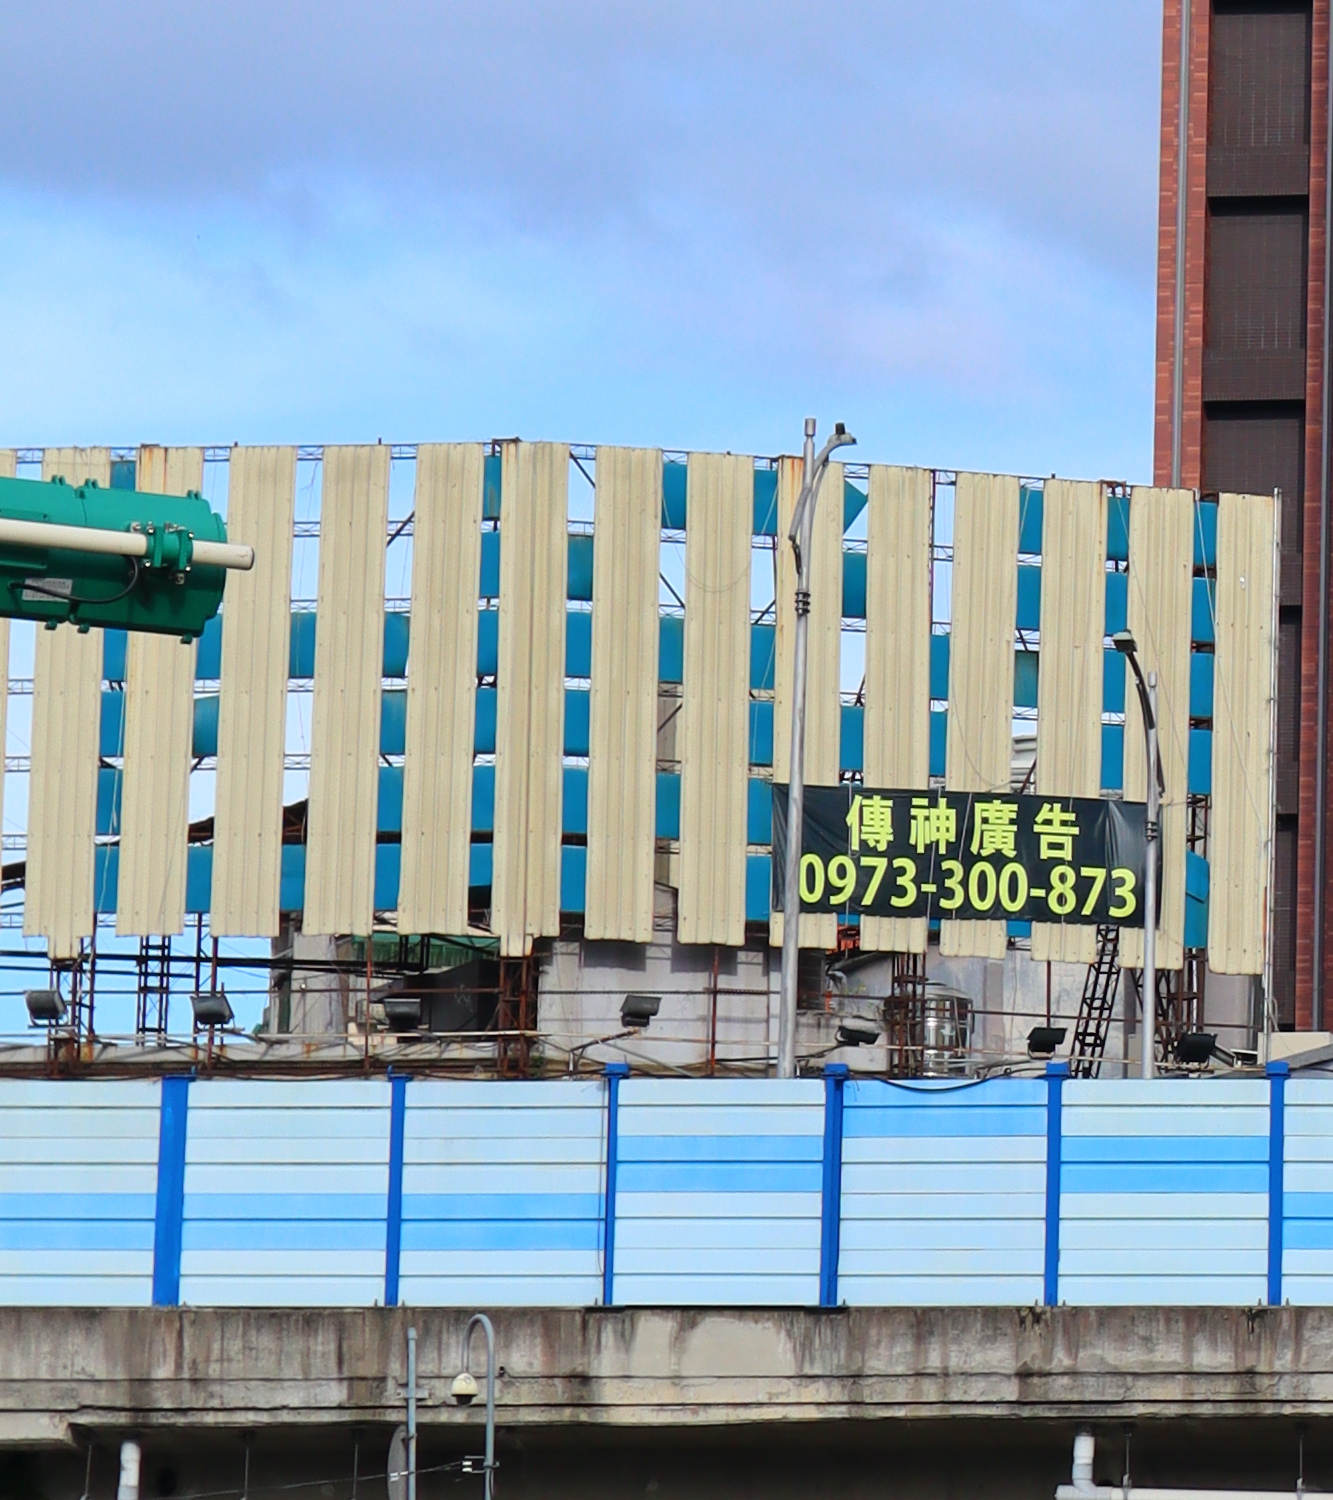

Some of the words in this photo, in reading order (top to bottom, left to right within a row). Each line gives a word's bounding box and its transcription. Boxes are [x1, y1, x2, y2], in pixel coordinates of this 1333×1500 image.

[845, 794, 1080, 862] 傳神廣告
[799, 853, 1137, 919] 0973-300-873
